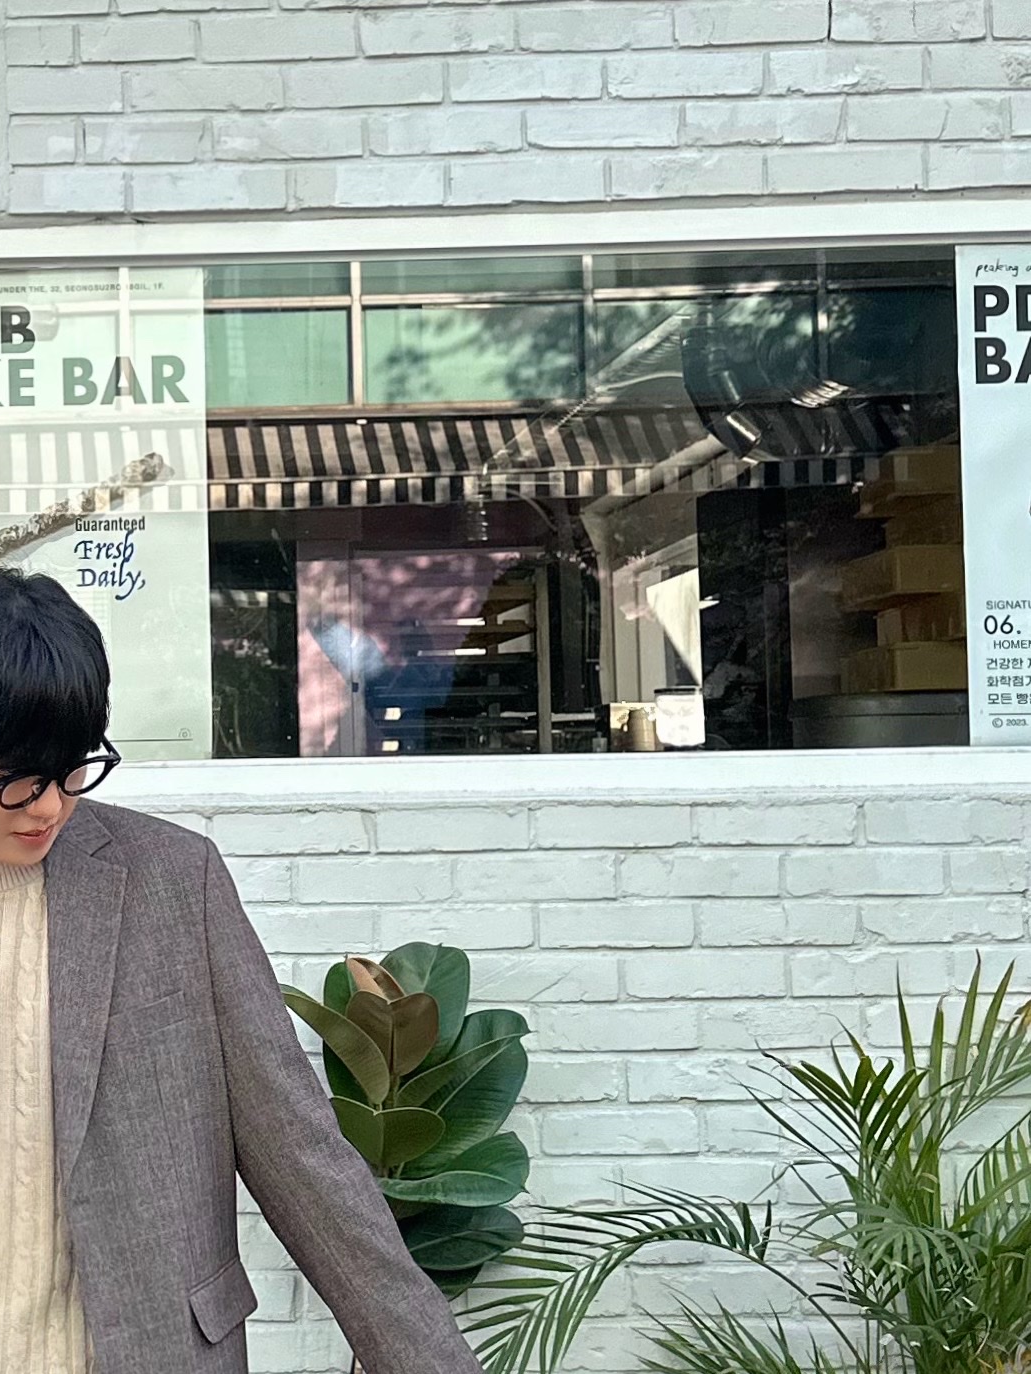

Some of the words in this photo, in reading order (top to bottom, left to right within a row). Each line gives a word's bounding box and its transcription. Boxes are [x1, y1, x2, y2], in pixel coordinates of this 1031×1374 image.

[62, 354, 190, 407] BAR
[75, 515, 146, 532] Guaranteed
[73, 529, 135, 562] Fresh
[983, 614, 1022, 635] 06.
[985, 657, 1024, 671] 건강한
[987, 692, 1013, 705] 모든
